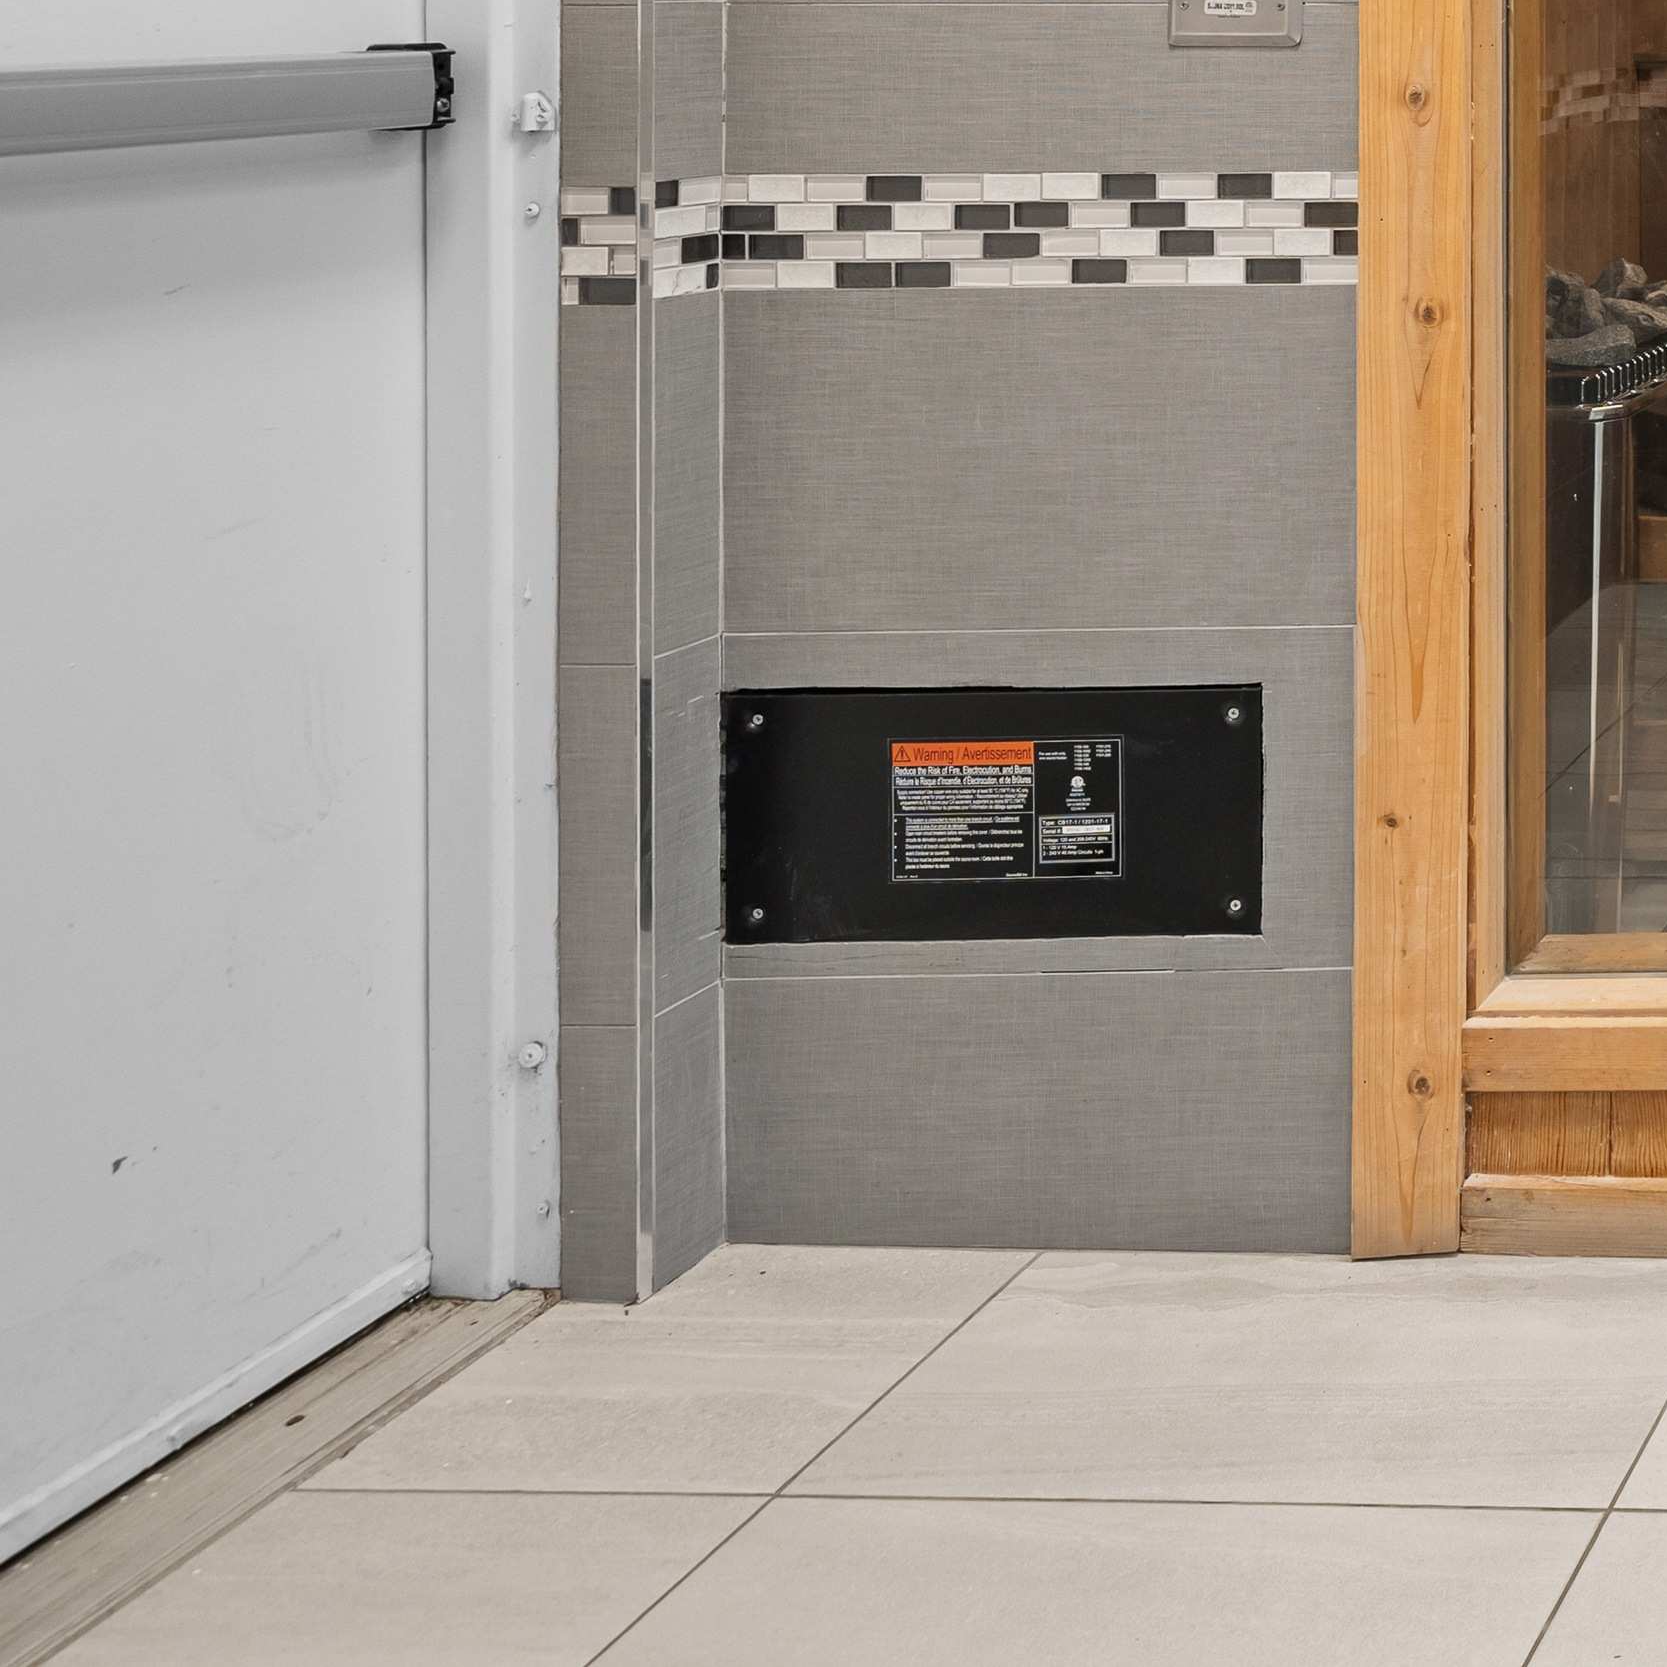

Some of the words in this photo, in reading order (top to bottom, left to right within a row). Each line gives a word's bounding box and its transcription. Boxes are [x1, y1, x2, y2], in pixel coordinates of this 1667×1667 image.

[913, 747, 954, 764] Warning
[961, 745, 1032, 760] Avertissement
[927, 766, 940, 775] Risk
